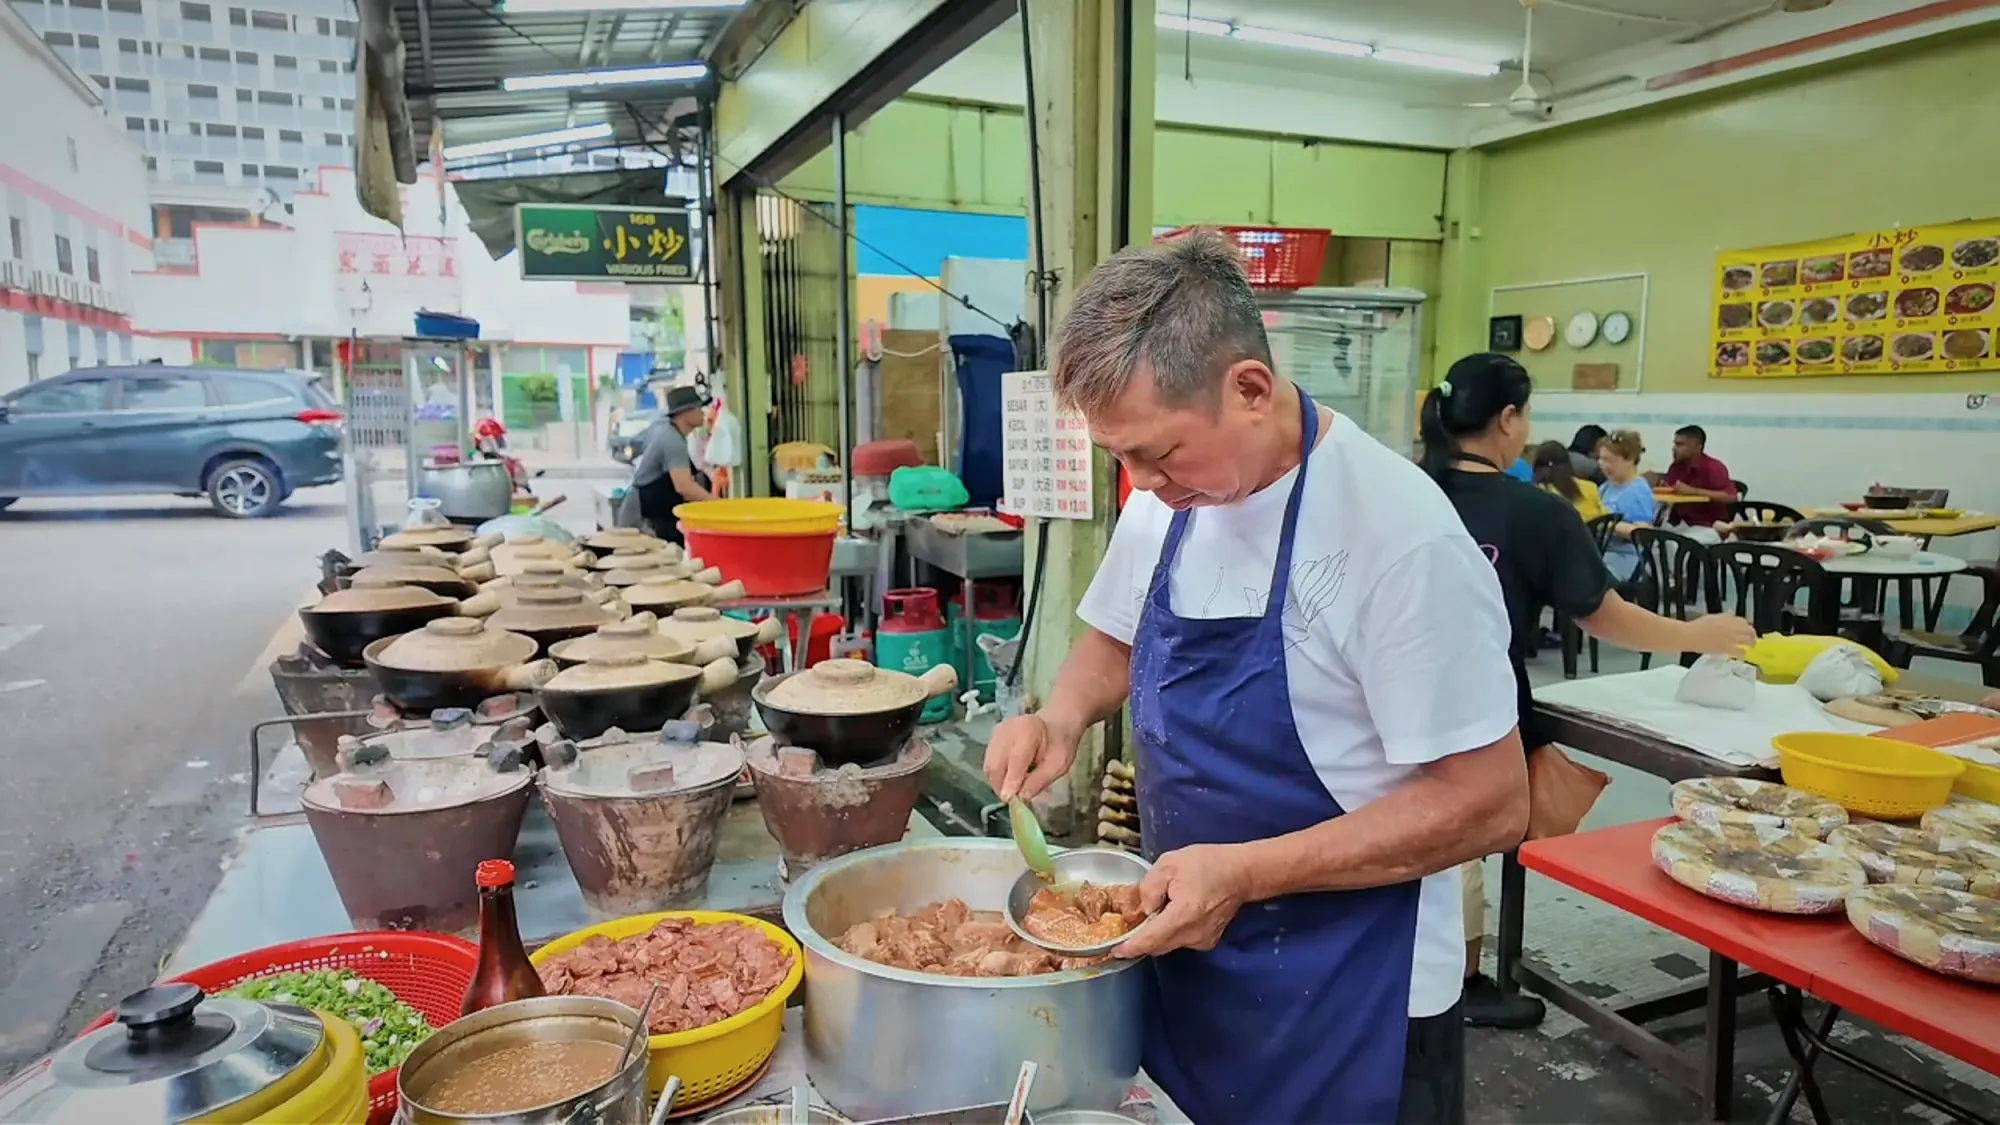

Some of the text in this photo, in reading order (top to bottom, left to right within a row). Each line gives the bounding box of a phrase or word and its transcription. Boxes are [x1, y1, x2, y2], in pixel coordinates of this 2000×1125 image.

[629, 213, 656, 225] 168
[526, 228, 590, 255] Carlsberg
[603, 224, 685, 262] 小炒
[1868, 229, 1919, 248] 小炒
[605, 263, 688, 276] VARIOUS FRIED
[1007, 399, 1027, 412] BESAR
[903, 655, 928, 665] GAS
